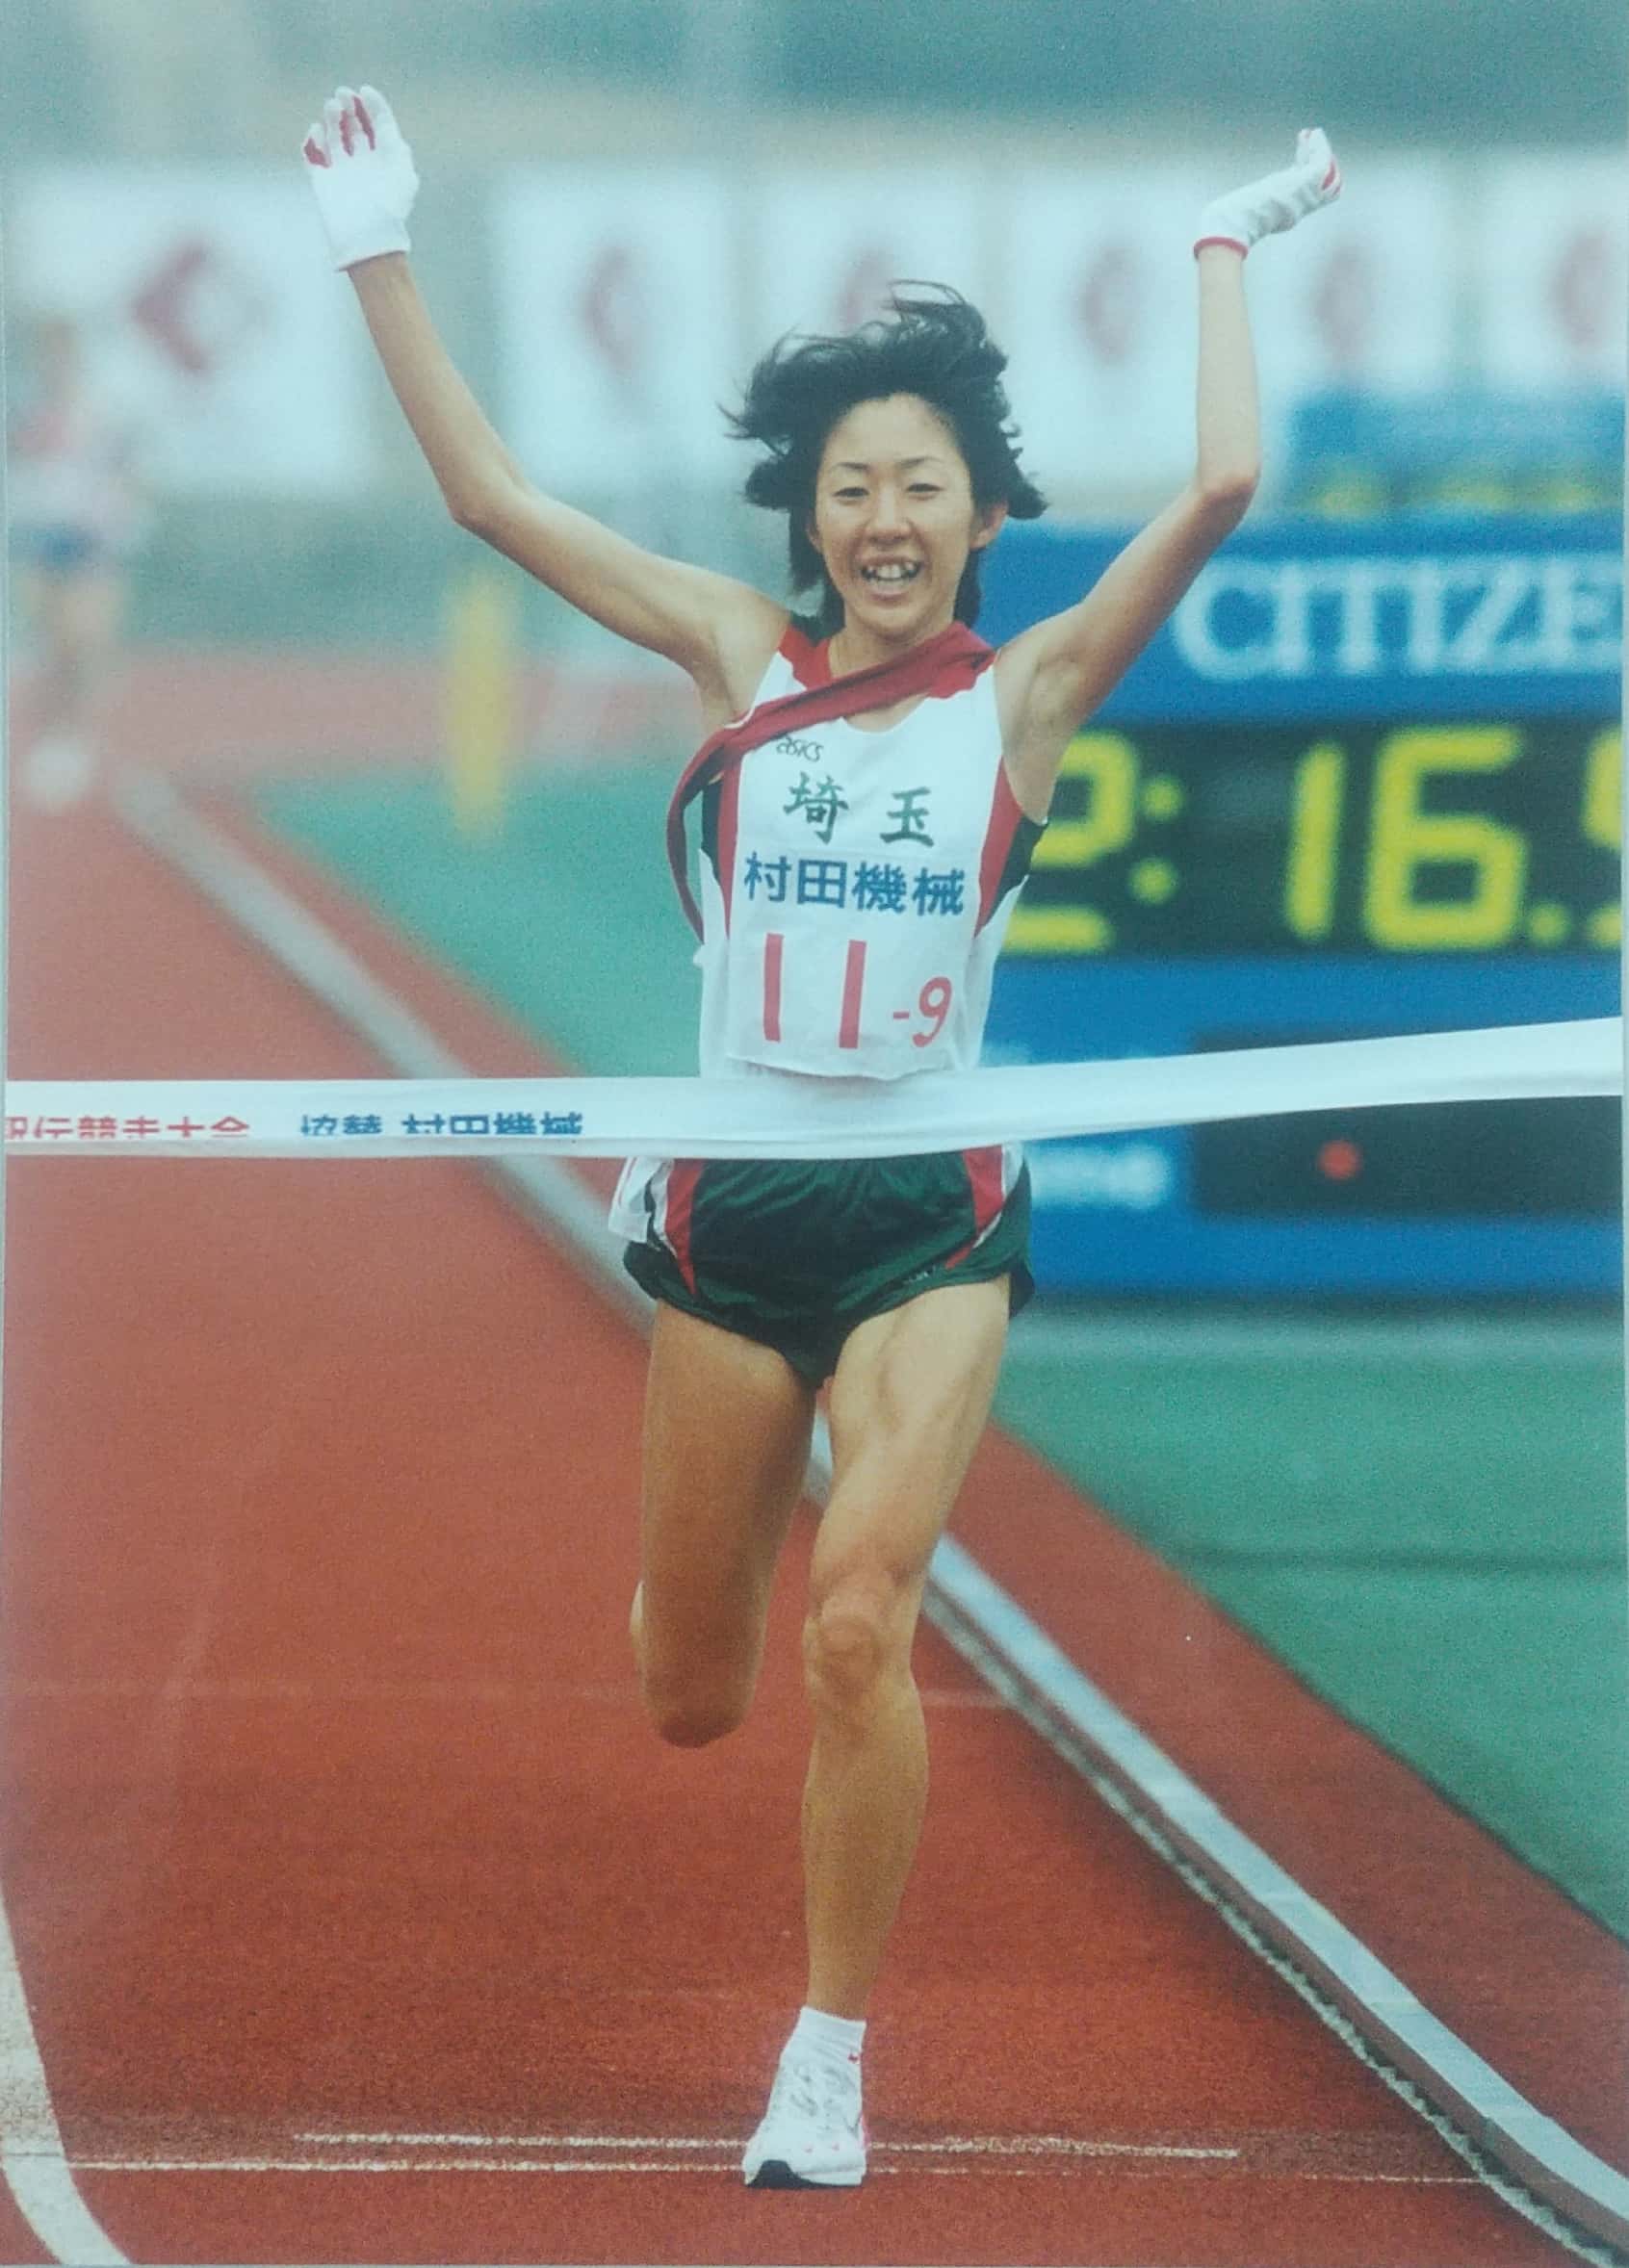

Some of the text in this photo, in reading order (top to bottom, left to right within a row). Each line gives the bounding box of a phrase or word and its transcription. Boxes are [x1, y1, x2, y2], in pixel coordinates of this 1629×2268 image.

[783, 771, 935, 847] 埼玉
[743, 851, 966, 916] 村田機械
[763, 932, 953, 1049] 11-9
